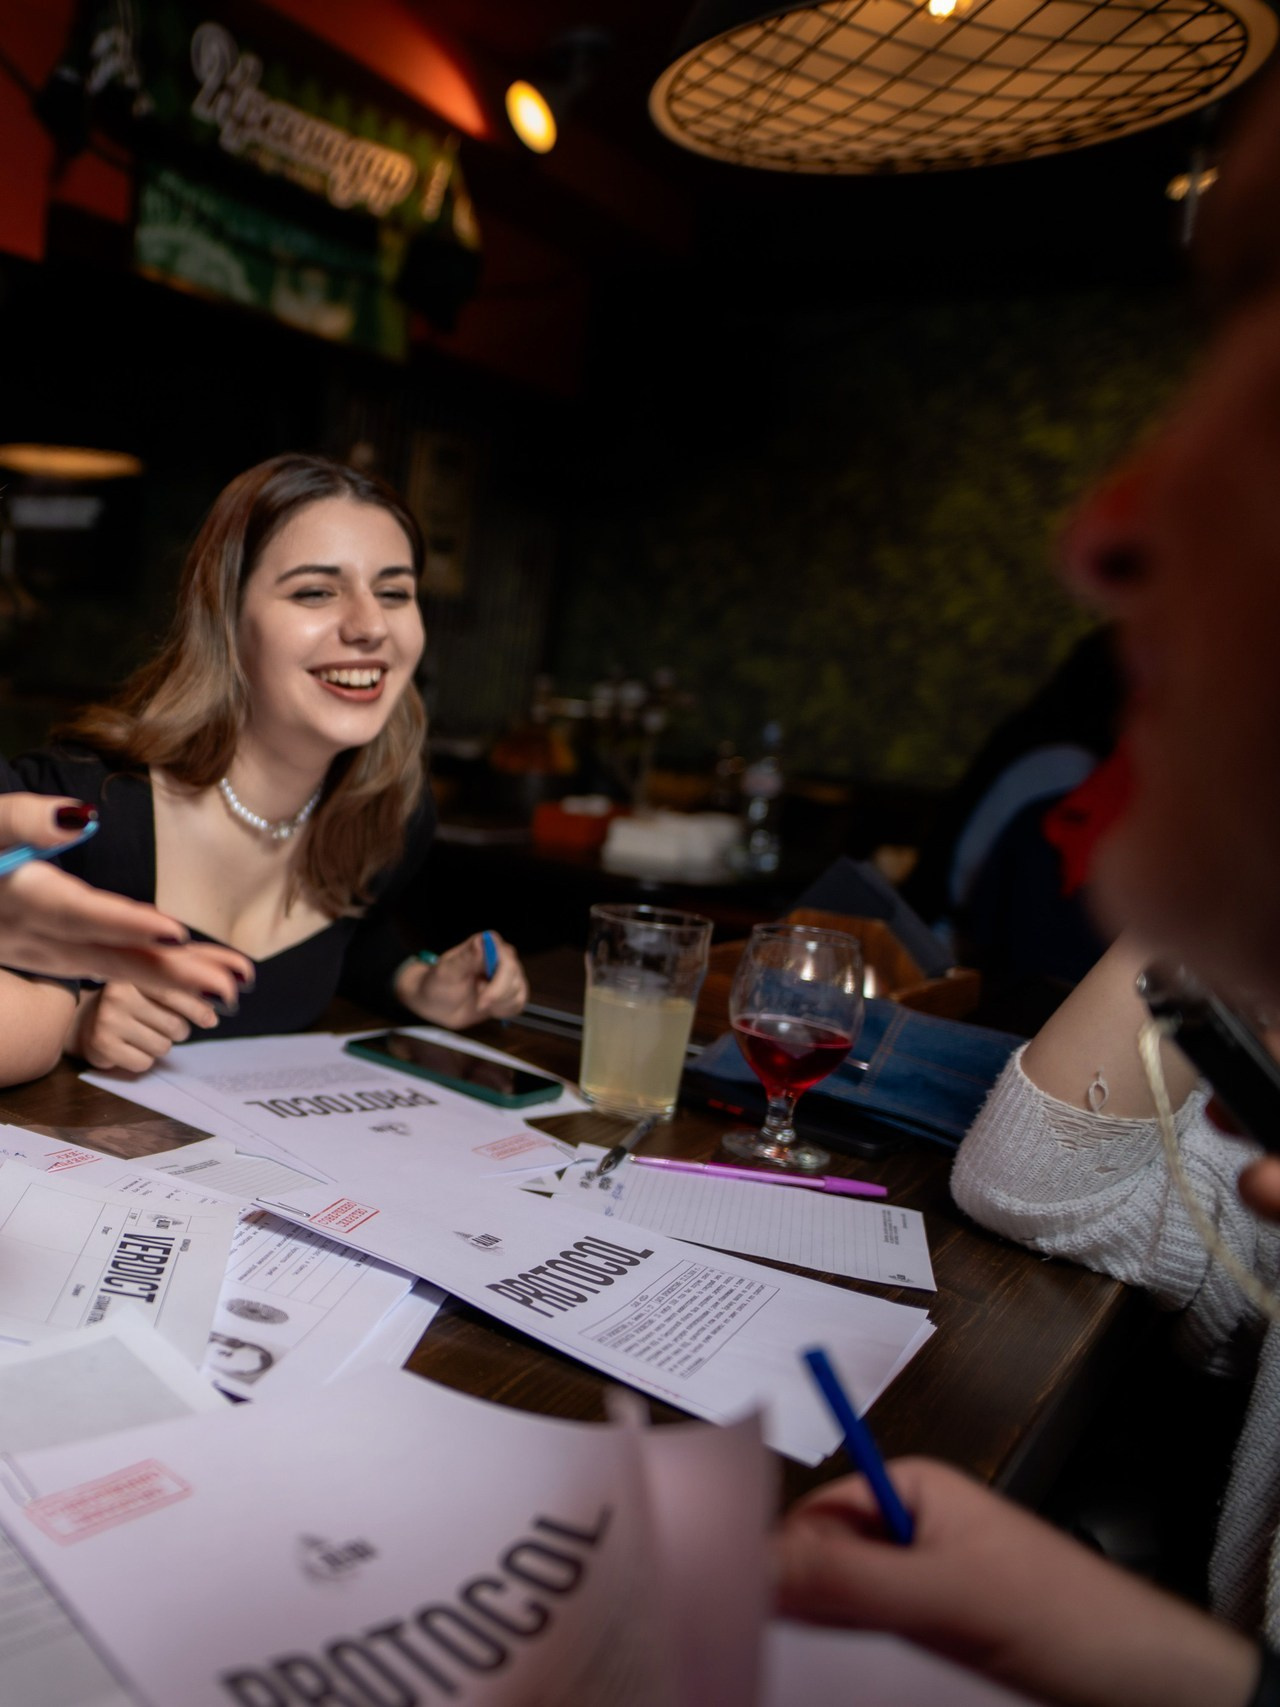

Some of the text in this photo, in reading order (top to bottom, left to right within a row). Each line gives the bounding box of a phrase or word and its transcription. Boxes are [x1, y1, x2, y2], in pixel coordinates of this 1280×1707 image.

[243, 1086, 439, 1119] PROTOCOL
[99, 1232, 175, 1303] VERDICT
[485, 1235, 655, 1318] PROTOCOL
